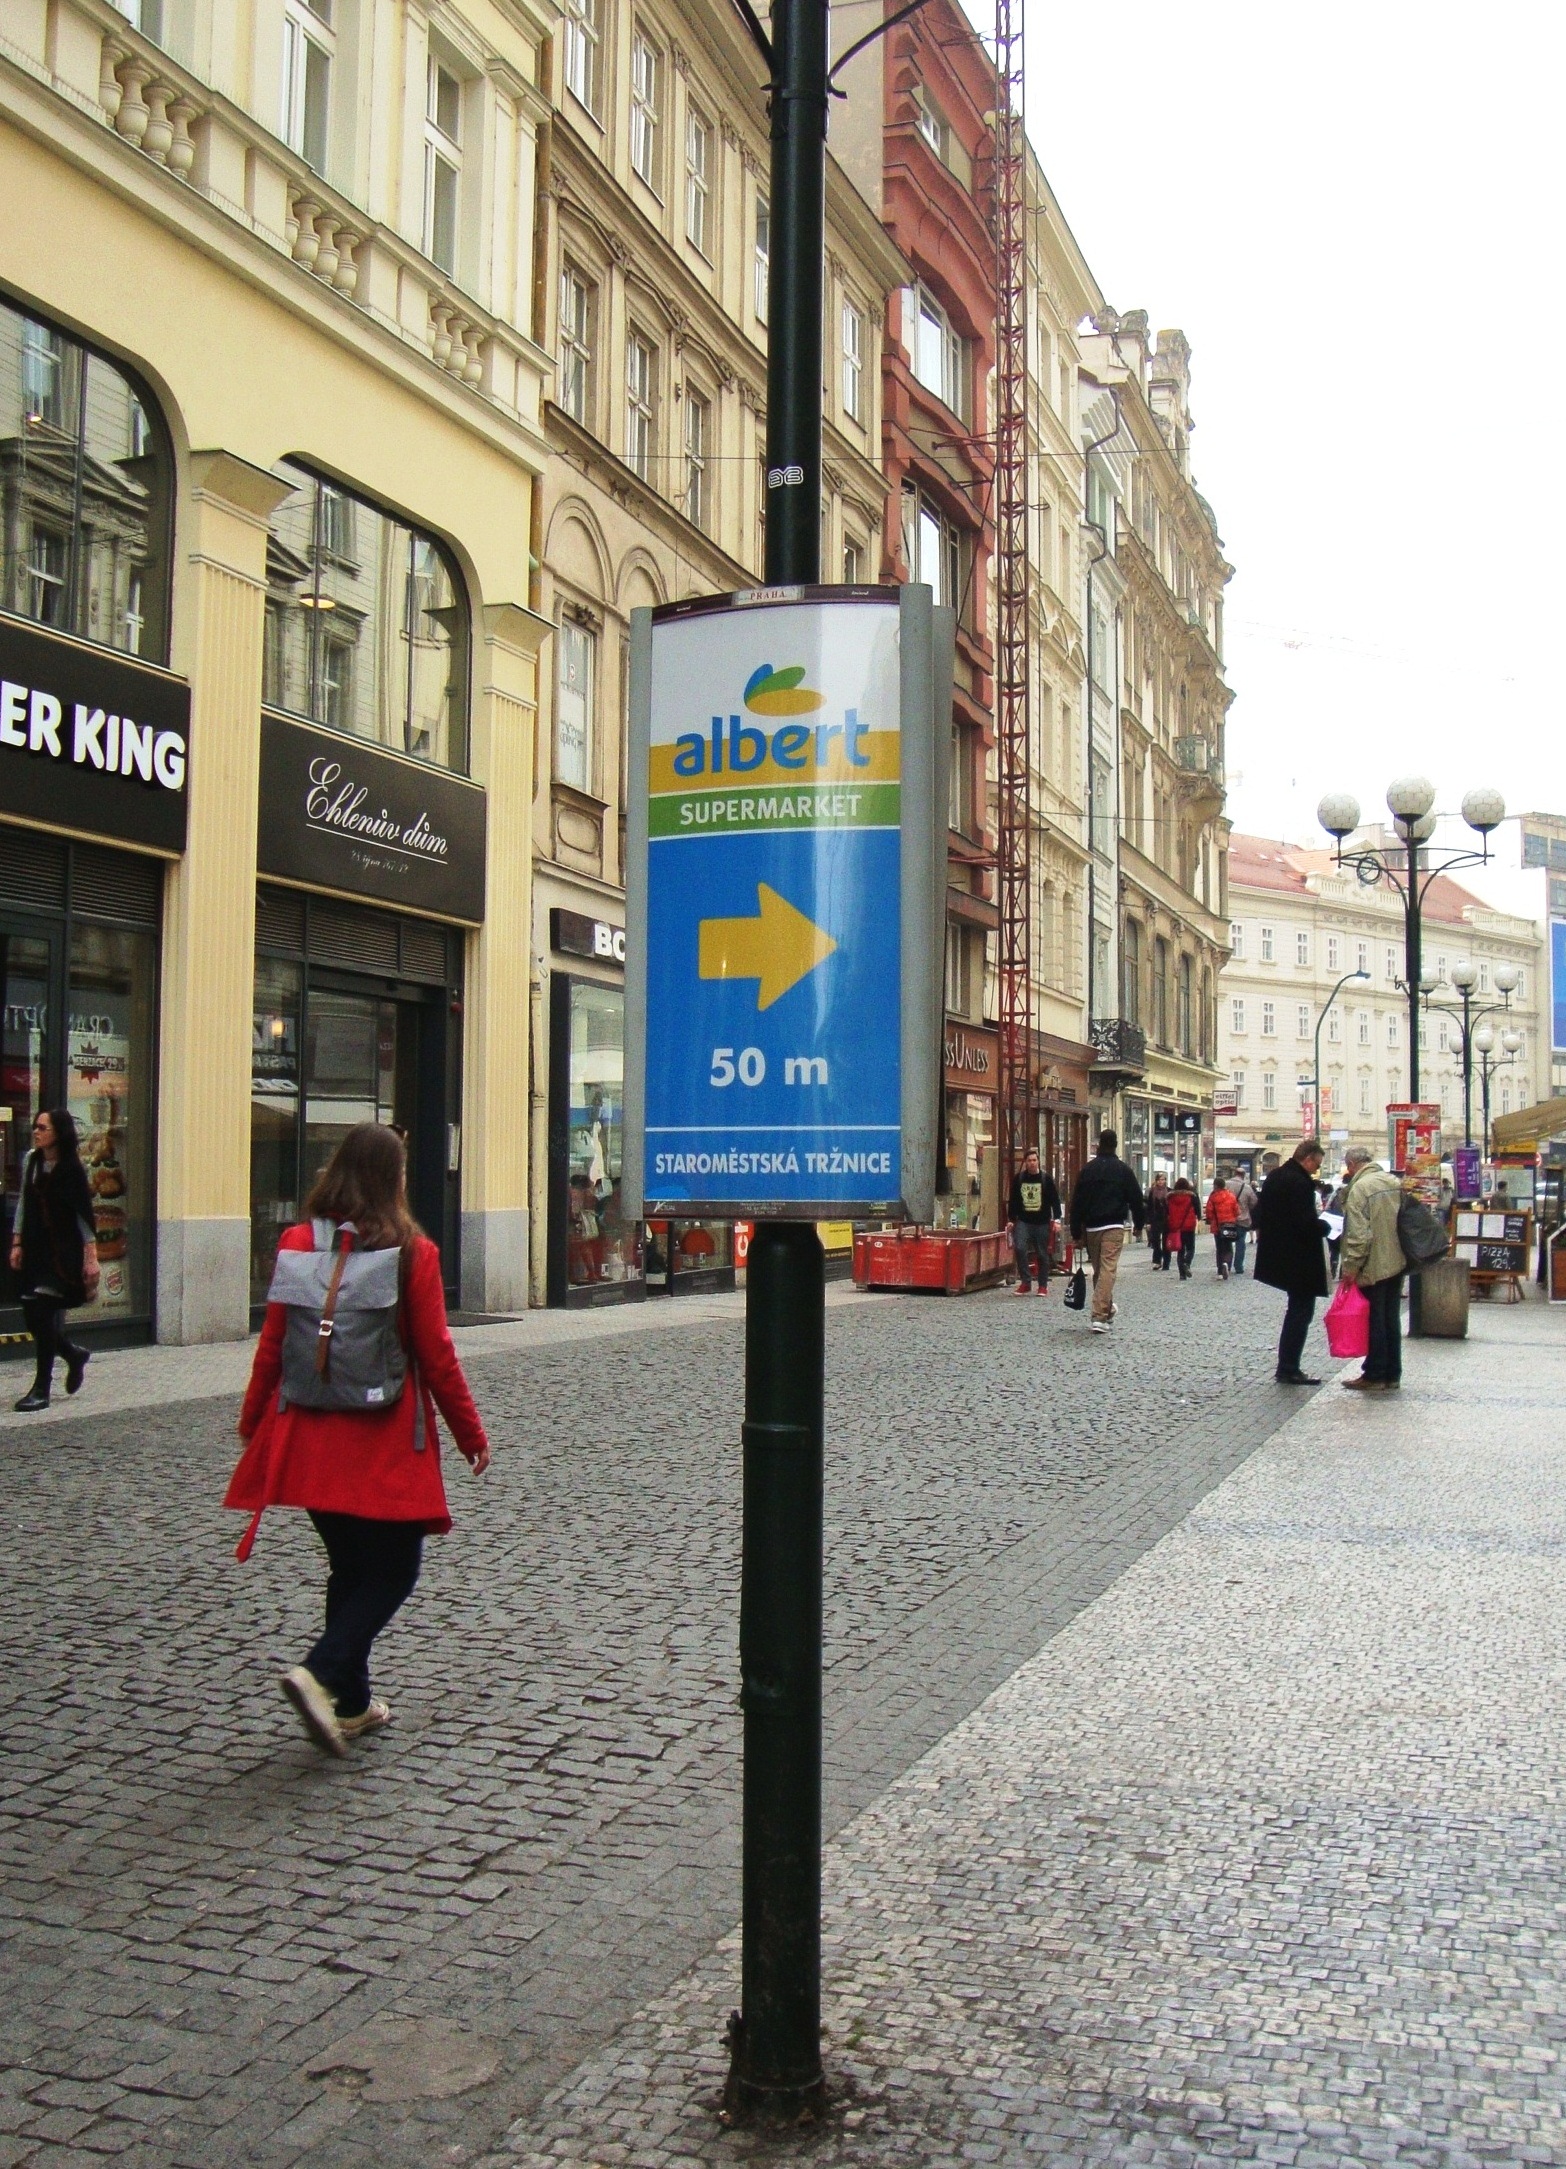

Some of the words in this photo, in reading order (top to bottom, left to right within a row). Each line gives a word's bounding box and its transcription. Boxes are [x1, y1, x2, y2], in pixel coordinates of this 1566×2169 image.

[750, 590, 786, 600] PRAHA
[73, 703, 186, 791] KING
[673, 708, 871, 777] albert
[306, 757, 400, 840] Ehlenův
[402, 812, 448, 854] dům
[680, 795, 862, 826] SUPERMARKET
[710, 1047, 766, 1088] 50
[784, 1056, 828, 1085] m
[656, 1147, 799, 1175] STAROMĚSTSKÁ
[805, 1147, 891, 1174] TRŽNICE
[1481, 1246, 1511, 1257] PIZZA
